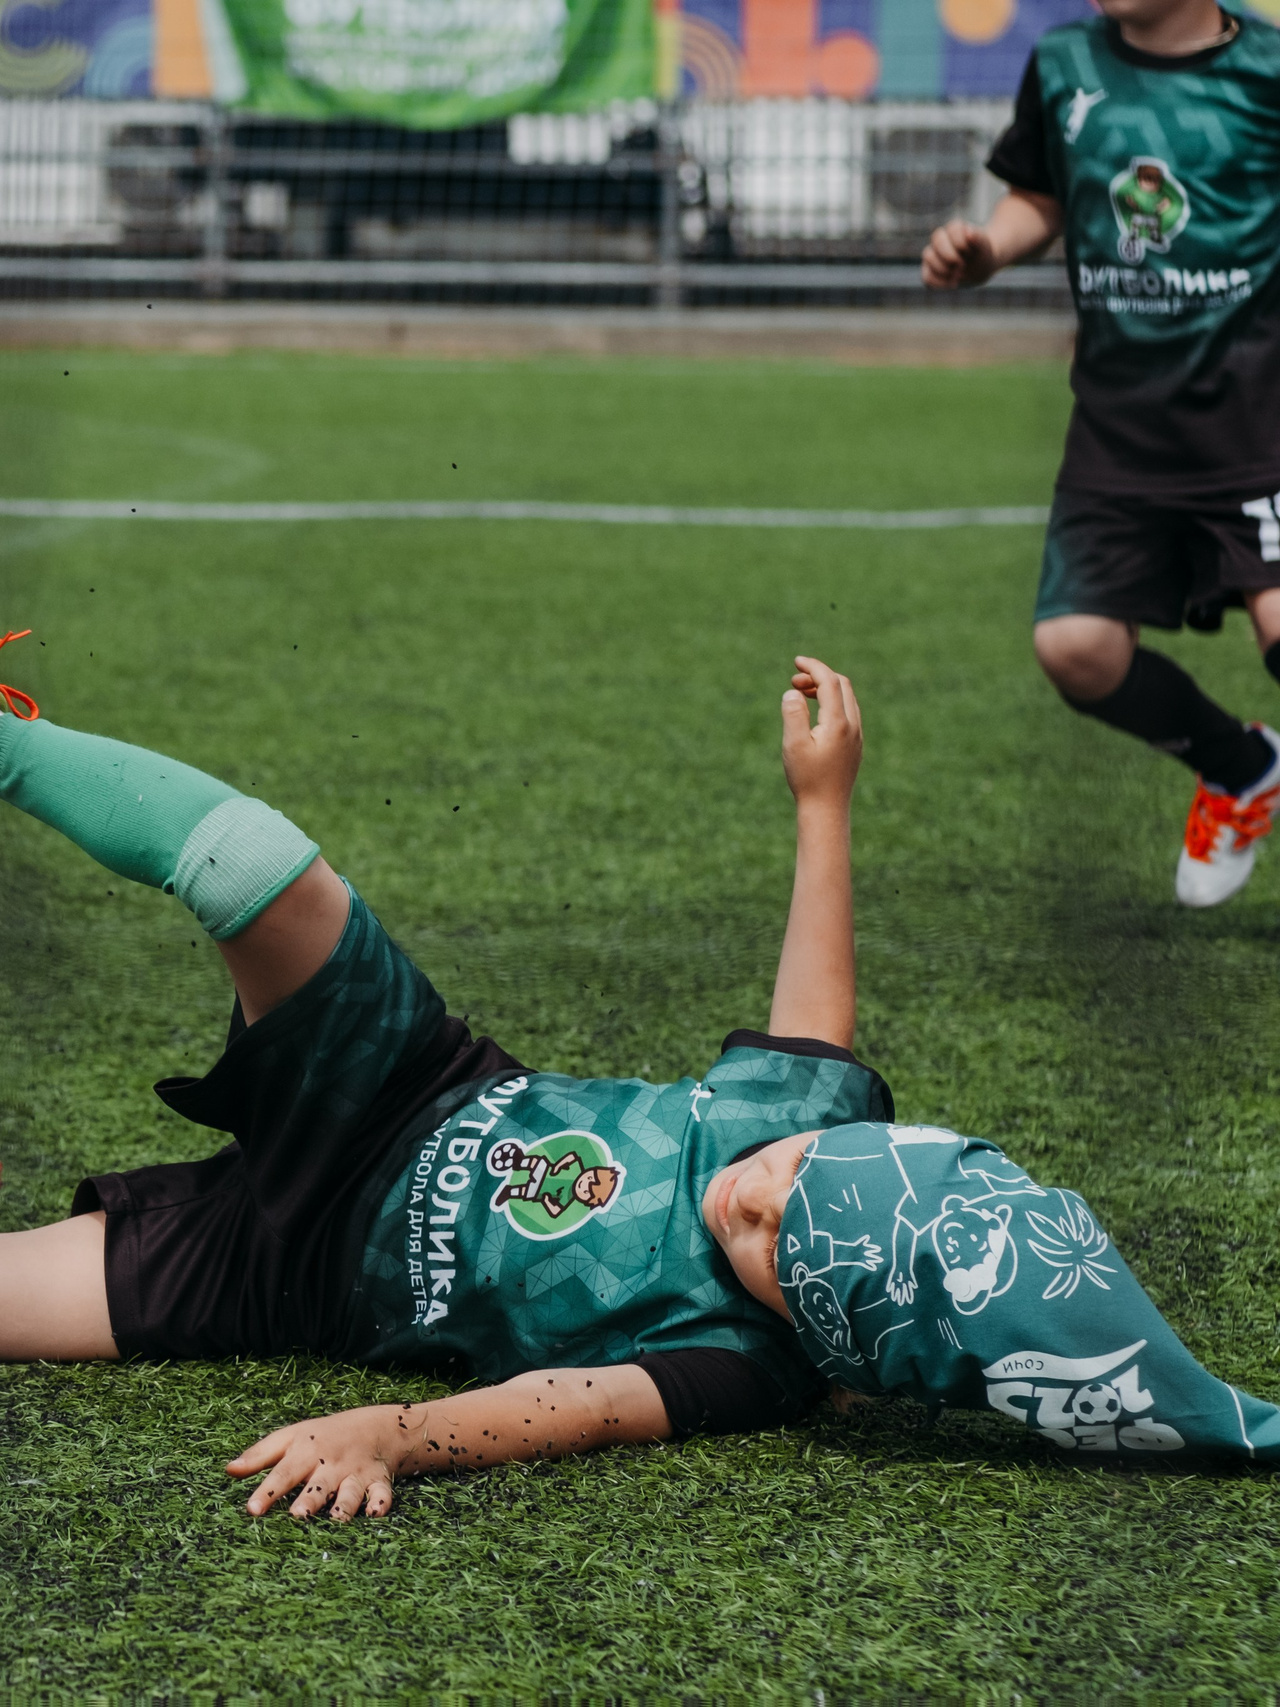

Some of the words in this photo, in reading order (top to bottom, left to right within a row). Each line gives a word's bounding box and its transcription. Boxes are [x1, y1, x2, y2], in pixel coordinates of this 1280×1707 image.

[1241, 491, 1280, 562] 1
[410, 1117, 450, 1204] УТБОЛА
[407, 1209, 423, 1253] ДЛЯ
[1002, 1358, 1045, 1374] СОЧИ
